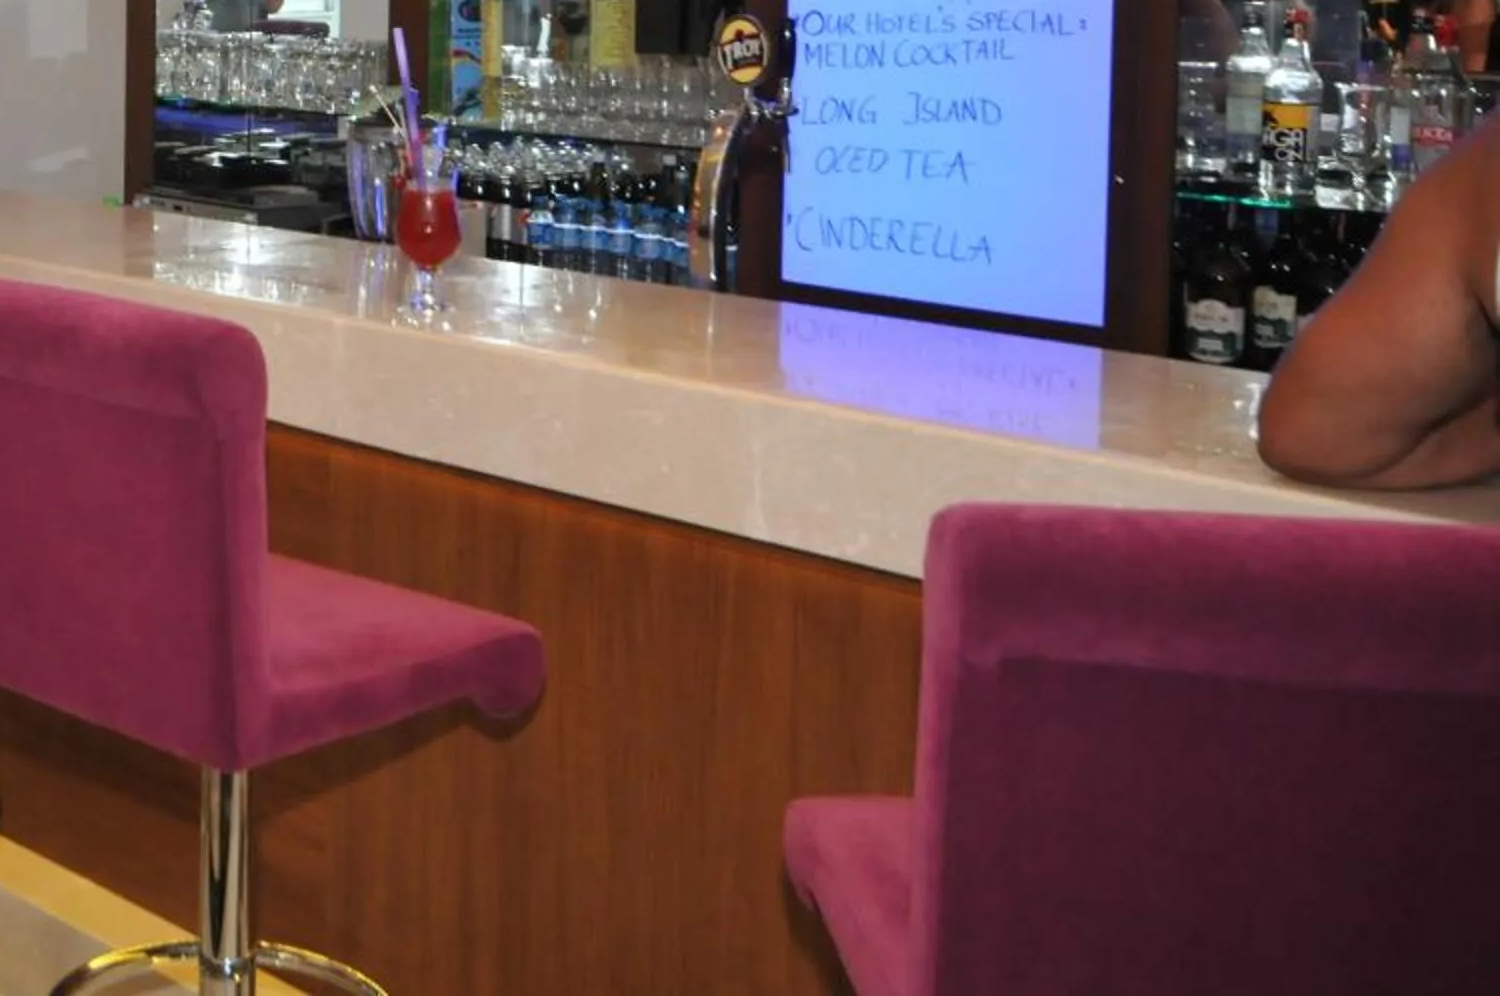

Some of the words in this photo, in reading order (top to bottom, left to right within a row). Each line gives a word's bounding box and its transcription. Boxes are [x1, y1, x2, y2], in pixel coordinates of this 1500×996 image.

[801, 10, 856, 37] OUR
[804, 41, 886, 70] MELON
[894, 38, 1015, 68] COCKTAIL
[801, 95, 878, 125] LONG
[903, 91, 1003, 126] ISLAND
[899, 148, 976, 185] TEA
[794, 206, 993, 265] CINDERELLA
